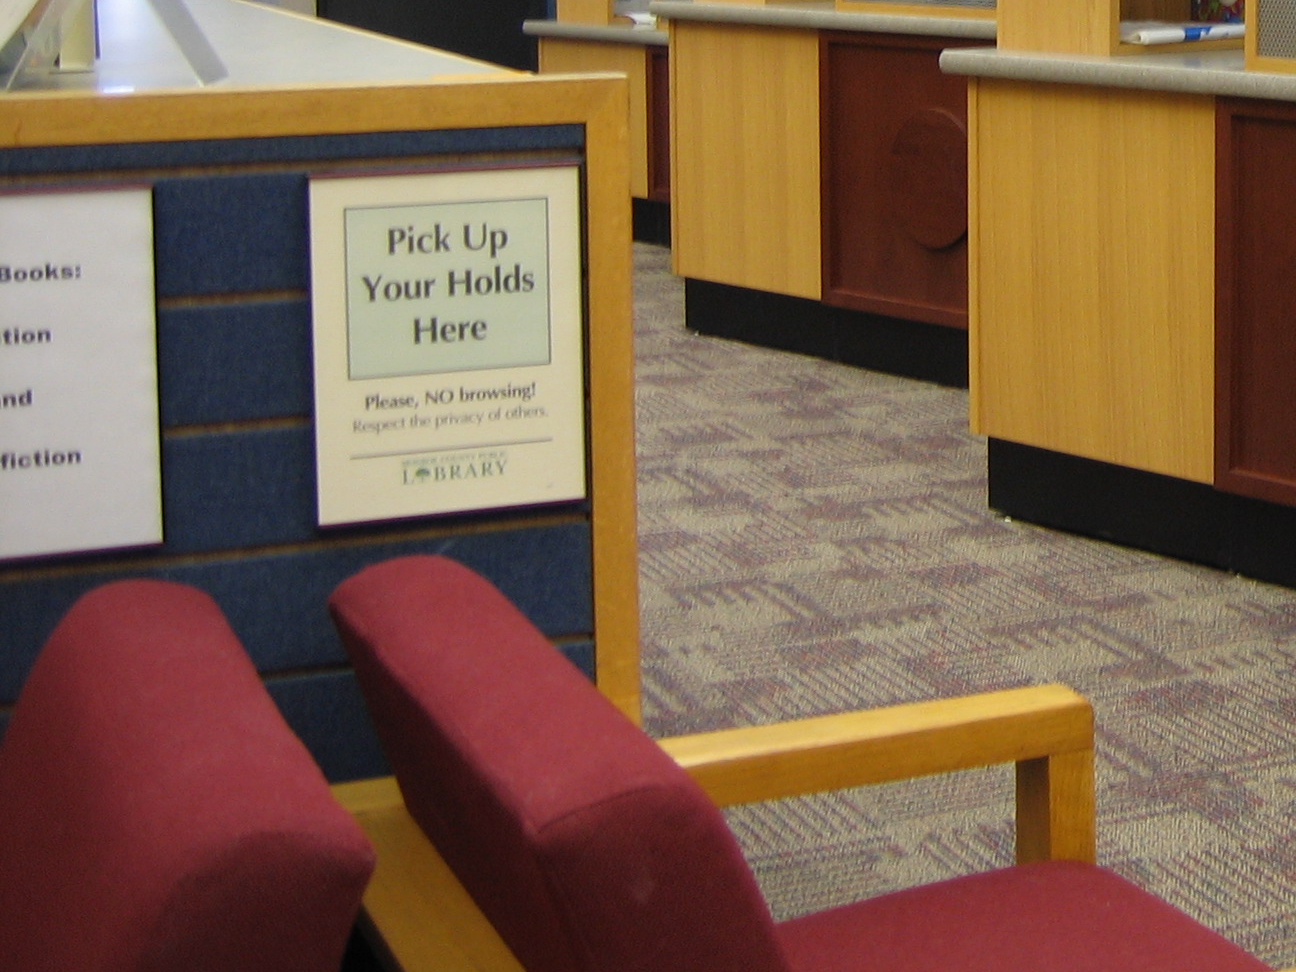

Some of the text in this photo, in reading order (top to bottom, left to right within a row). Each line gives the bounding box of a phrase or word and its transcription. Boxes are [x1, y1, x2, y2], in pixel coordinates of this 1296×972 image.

[387, 222, 508, 259] Pick Up
[0, 263, 82, 283] Books:
[362, 264, 536, 302] Your Holds
[0, 328, 51, 345] tion
[413, 317, 488, 345] Here
[0, 389, 33, 408] nd
[364, 381, 537, 412] Please, NO browsing!
[352, 417, 406, 436] Respect
[410, 413, 431, 428] the
[434, 411, 484, 430] privacy
[488, 406, 502, 421] of
